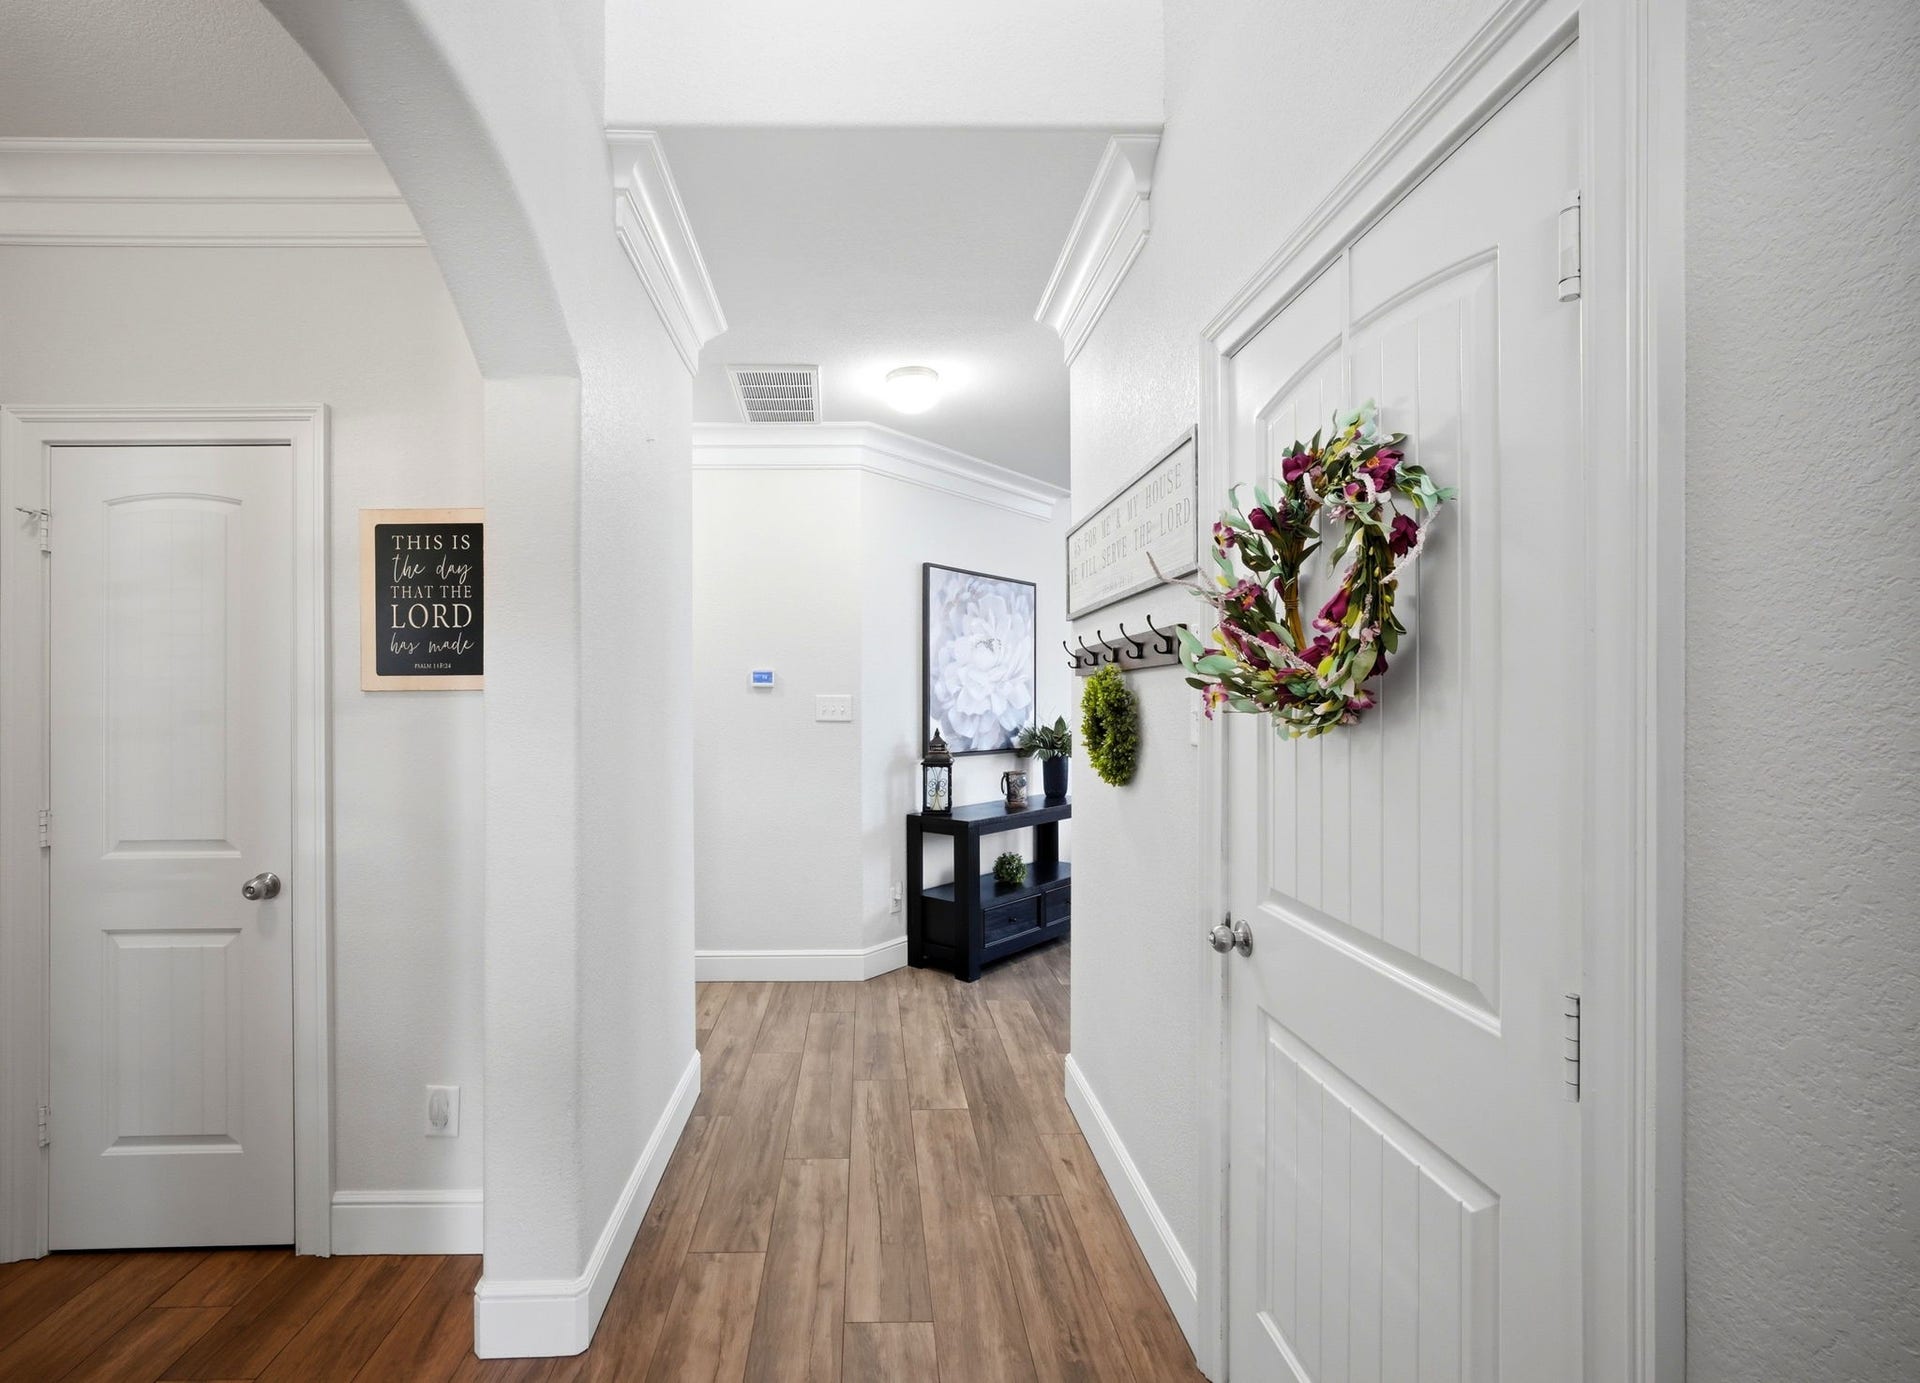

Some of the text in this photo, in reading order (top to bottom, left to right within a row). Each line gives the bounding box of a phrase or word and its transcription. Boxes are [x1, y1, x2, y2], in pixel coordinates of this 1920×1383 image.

[1083, 526, 1097, 552] FOR
[1127, 493, 1138, 522] MY
[1145, 463, 1181, 510] HOUSE
[391, 534, 471, 550] THIS IS
[1102, 535, 1127, 569] SERVE
[1134, 520, 1152, 552] THE
[1159, 497, 1191, 537] LORD
[391, 553, 473, 585] the day
[390, 585, 473, 599] THAT THE
[391, 603, 473, 629] LORD
[390, 631, 475, 655] has made
[414, 662, 431, 670] PSALM
